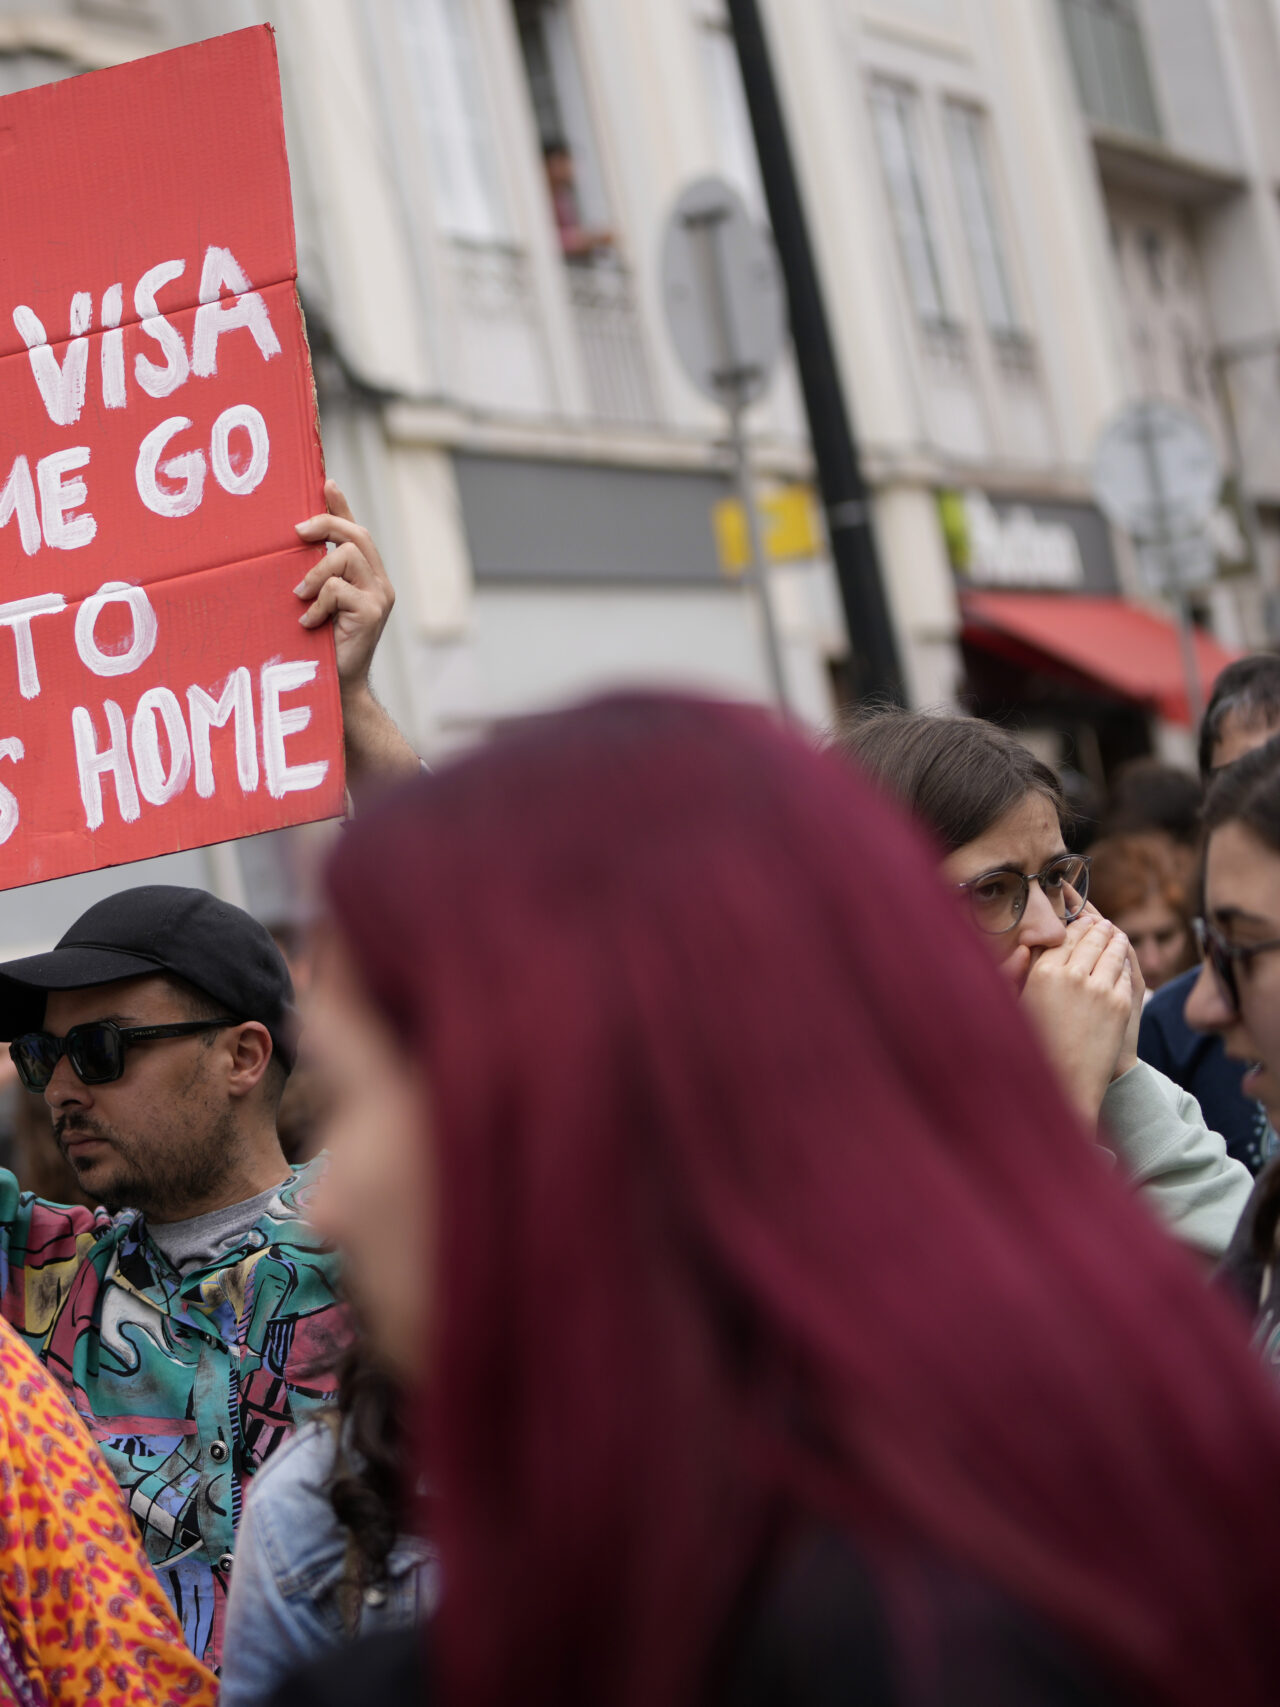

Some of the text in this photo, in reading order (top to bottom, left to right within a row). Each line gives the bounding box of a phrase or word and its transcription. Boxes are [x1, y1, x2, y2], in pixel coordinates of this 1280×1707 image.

[13, 246, 282, 426] VISA
[135, 404, 270, 518] GO
[72, 656, 329, 832] HOME
